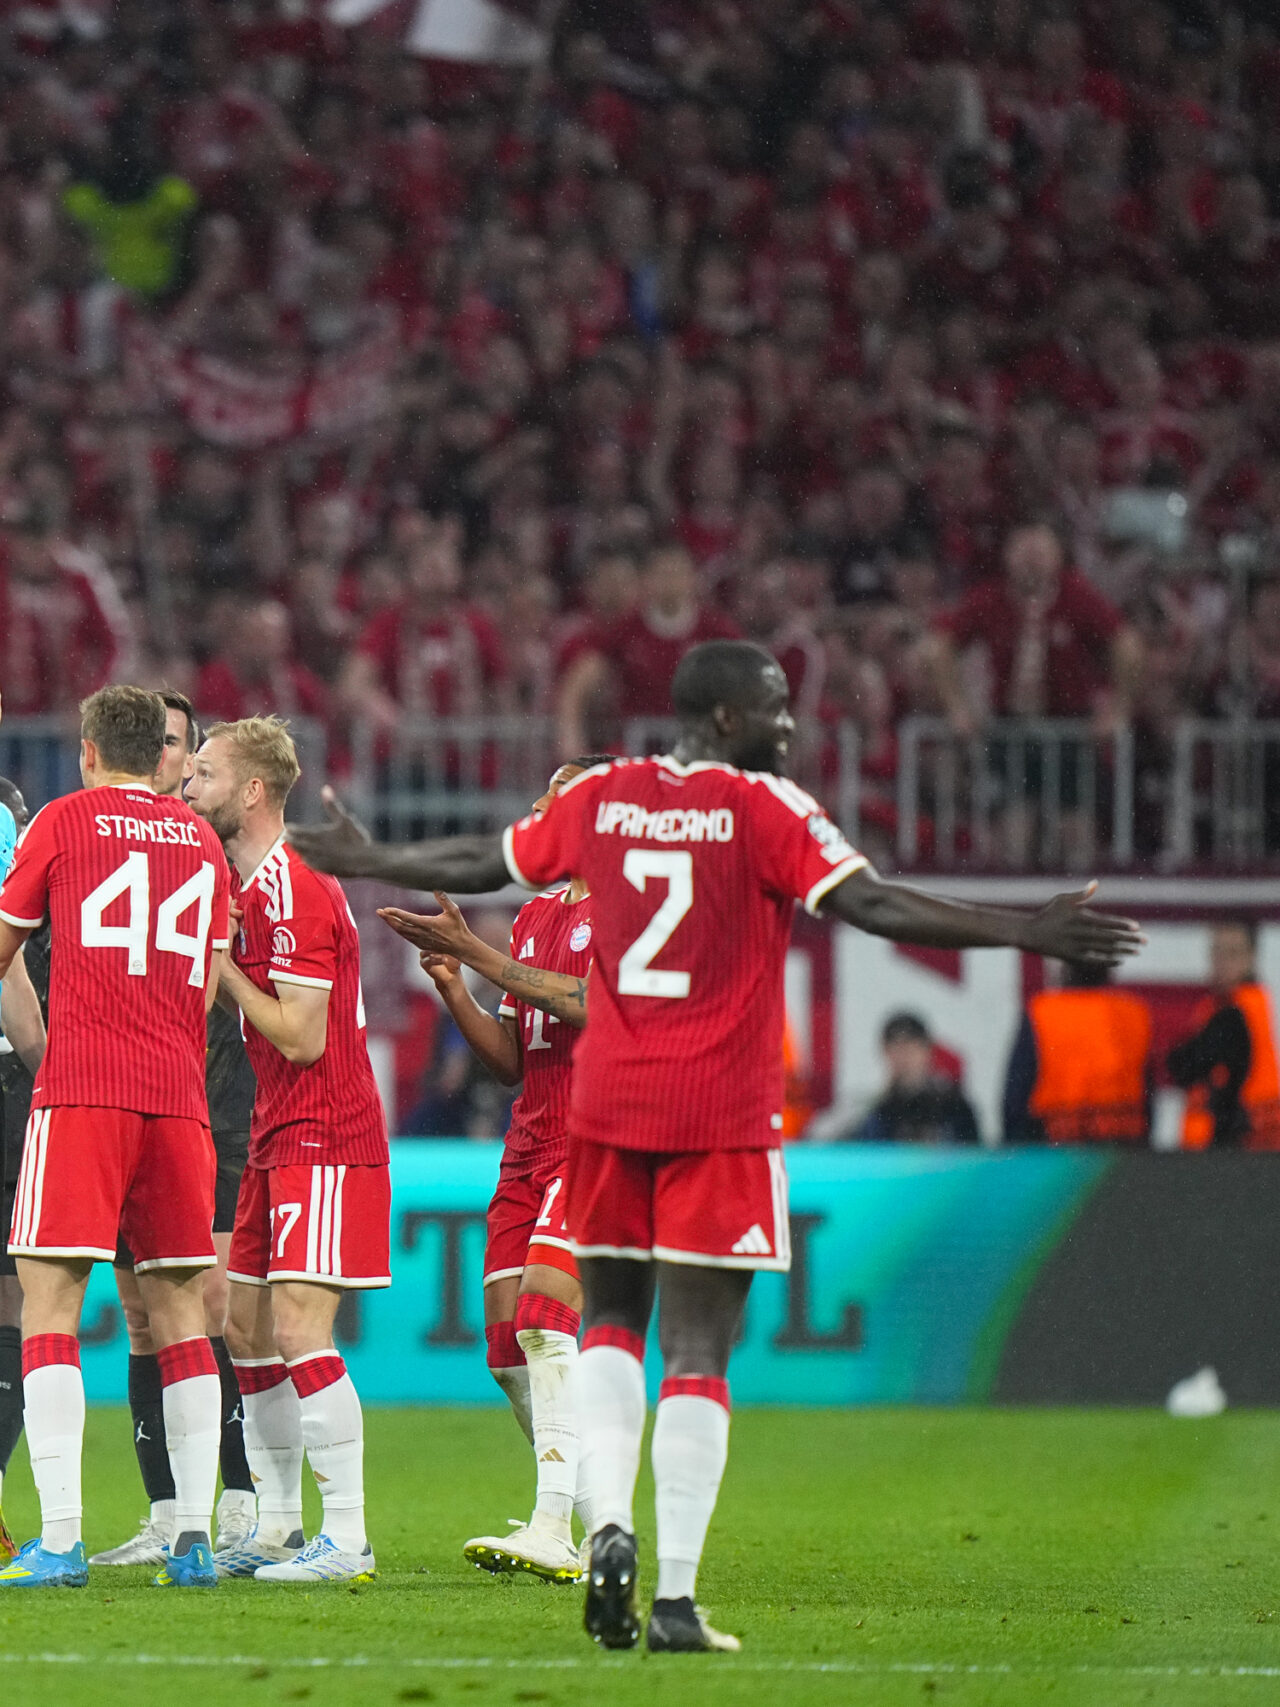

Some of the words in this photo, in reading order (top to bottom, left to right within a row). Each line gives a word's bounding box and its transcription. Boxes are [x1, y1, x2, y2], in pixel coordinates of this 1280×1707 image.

[95, 814, 201, 847] STANIŠIĆ
[595, 801, 734, 843] UPAMECANO
[81, 850, 215, 989] 44
[617, 848, 694, 999] 2
[535, 1177, 568, 1230] 1
